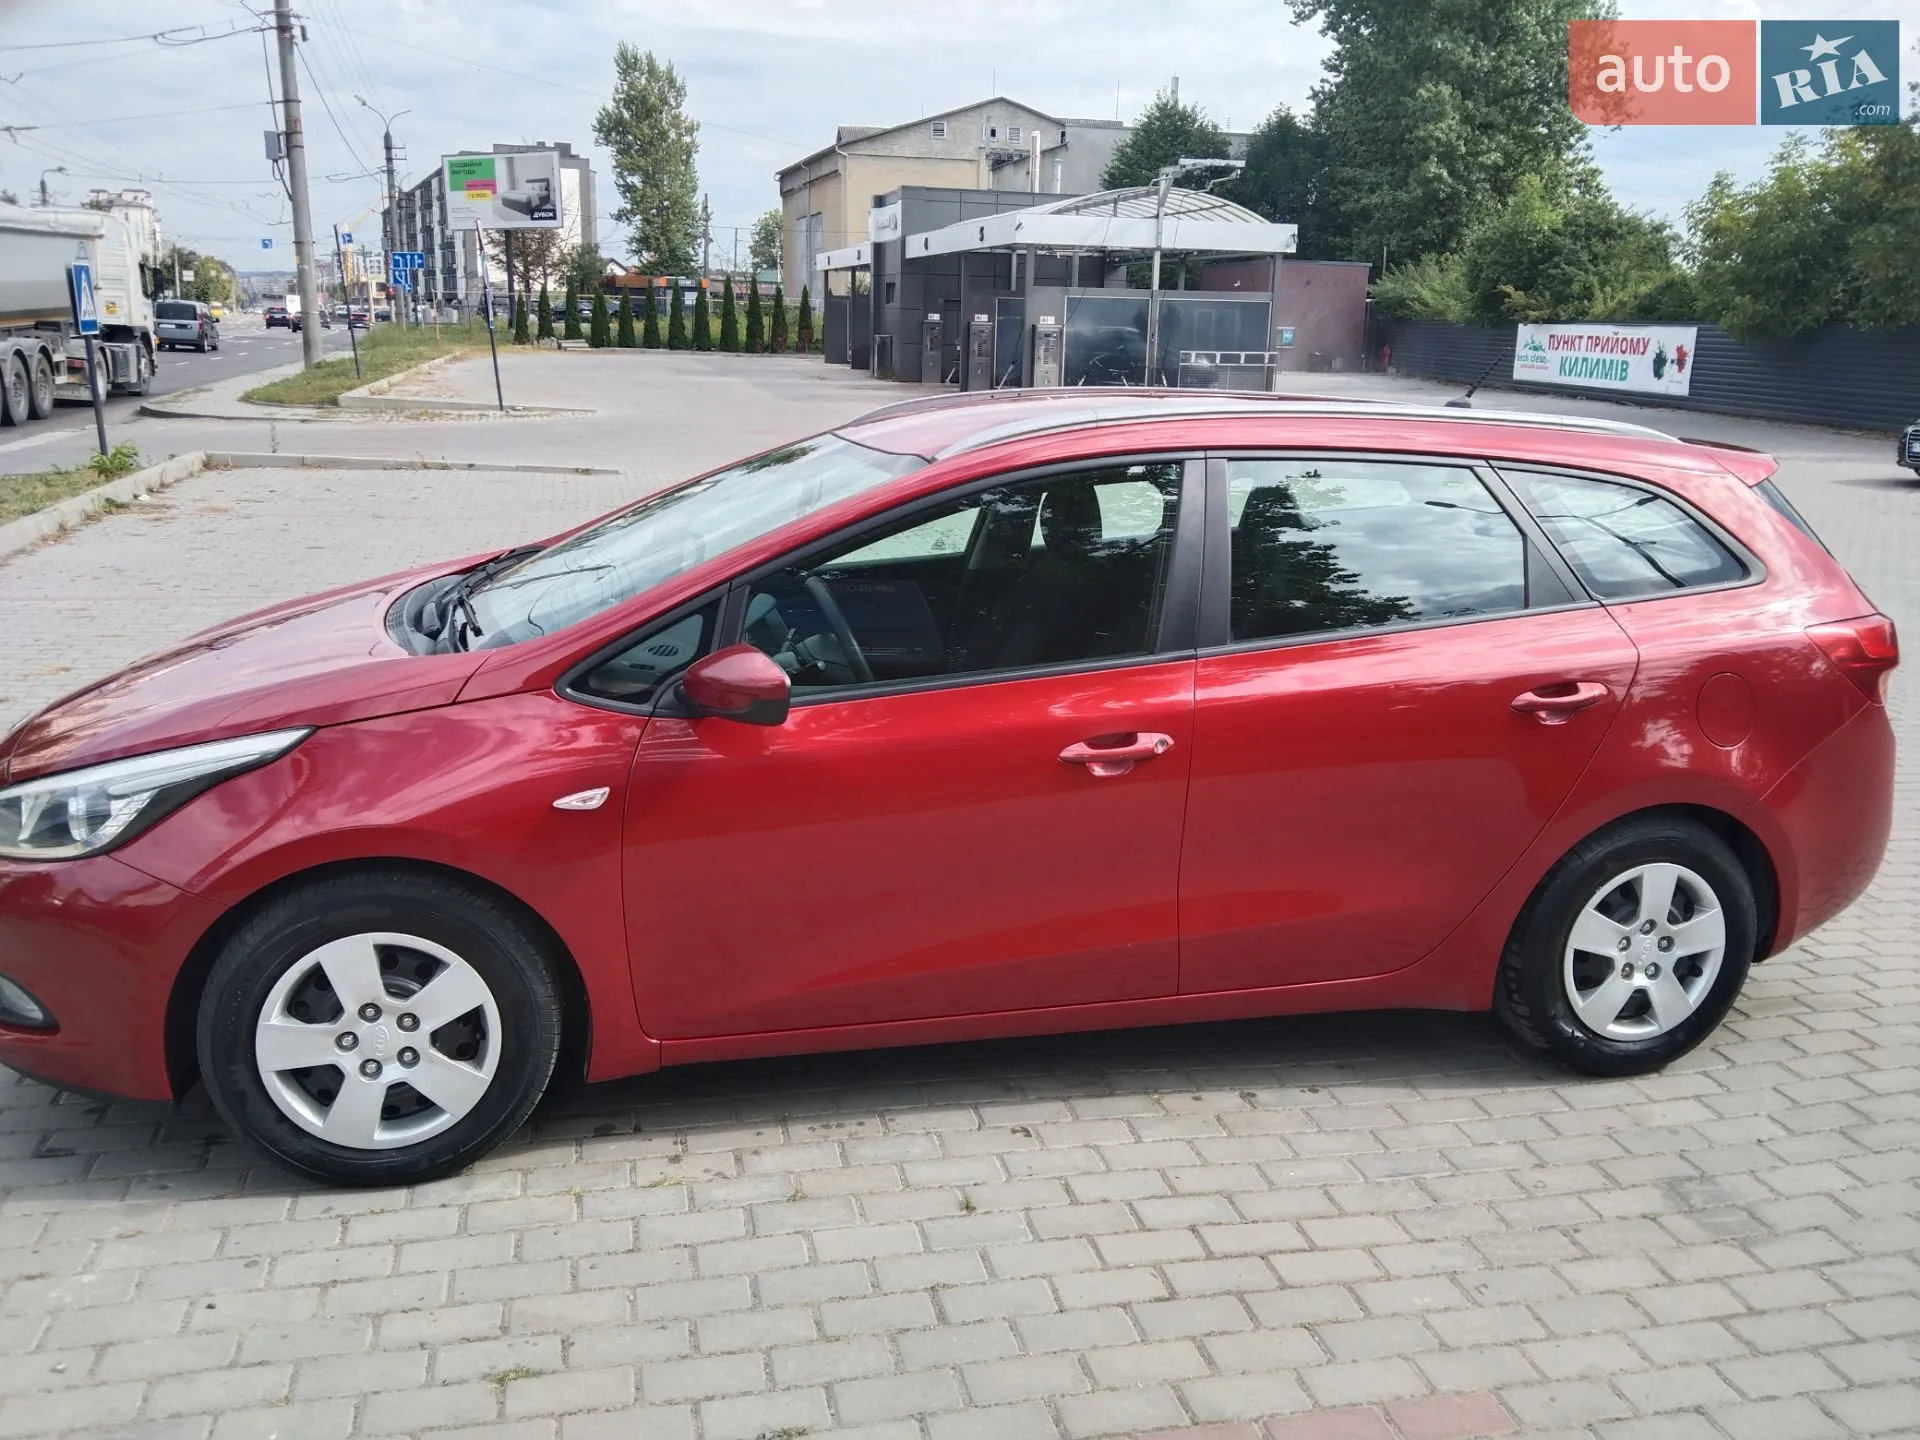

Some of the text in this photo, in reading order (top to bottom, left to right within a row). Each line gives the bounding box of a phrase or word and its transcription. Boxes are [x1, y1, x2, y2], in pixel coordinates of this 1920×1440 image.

[1547, 331, 1651, 356] ПУНКТ ПРИЙОМУ
[1559, 356, 1630, 382] КИЛИМІВ
